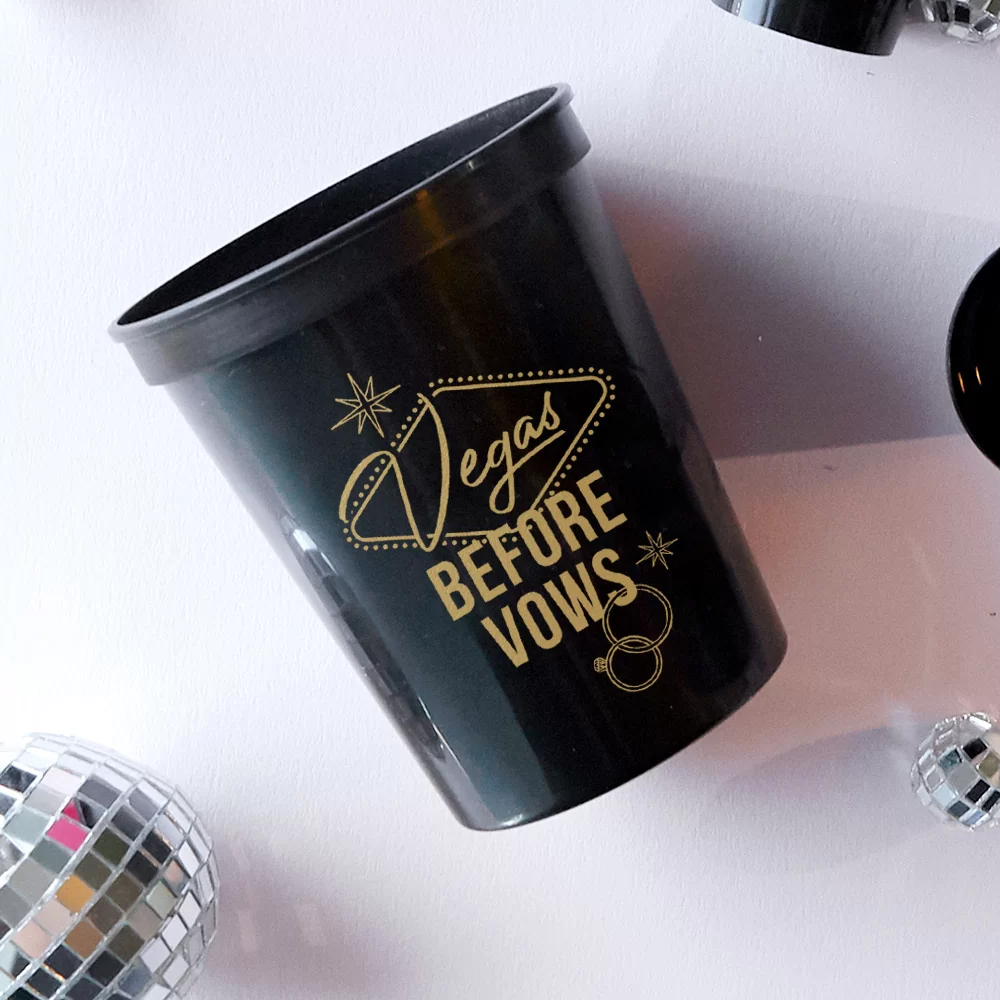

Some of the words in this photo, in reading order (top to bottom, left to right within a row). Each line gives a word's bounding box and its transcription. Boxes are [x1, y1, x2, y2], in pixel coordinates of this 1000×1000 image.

[339, 391, 566, 552] Vegas
[426, 469, 628, 621] BEFORE
[481, 549, 638, 668] VOWS
